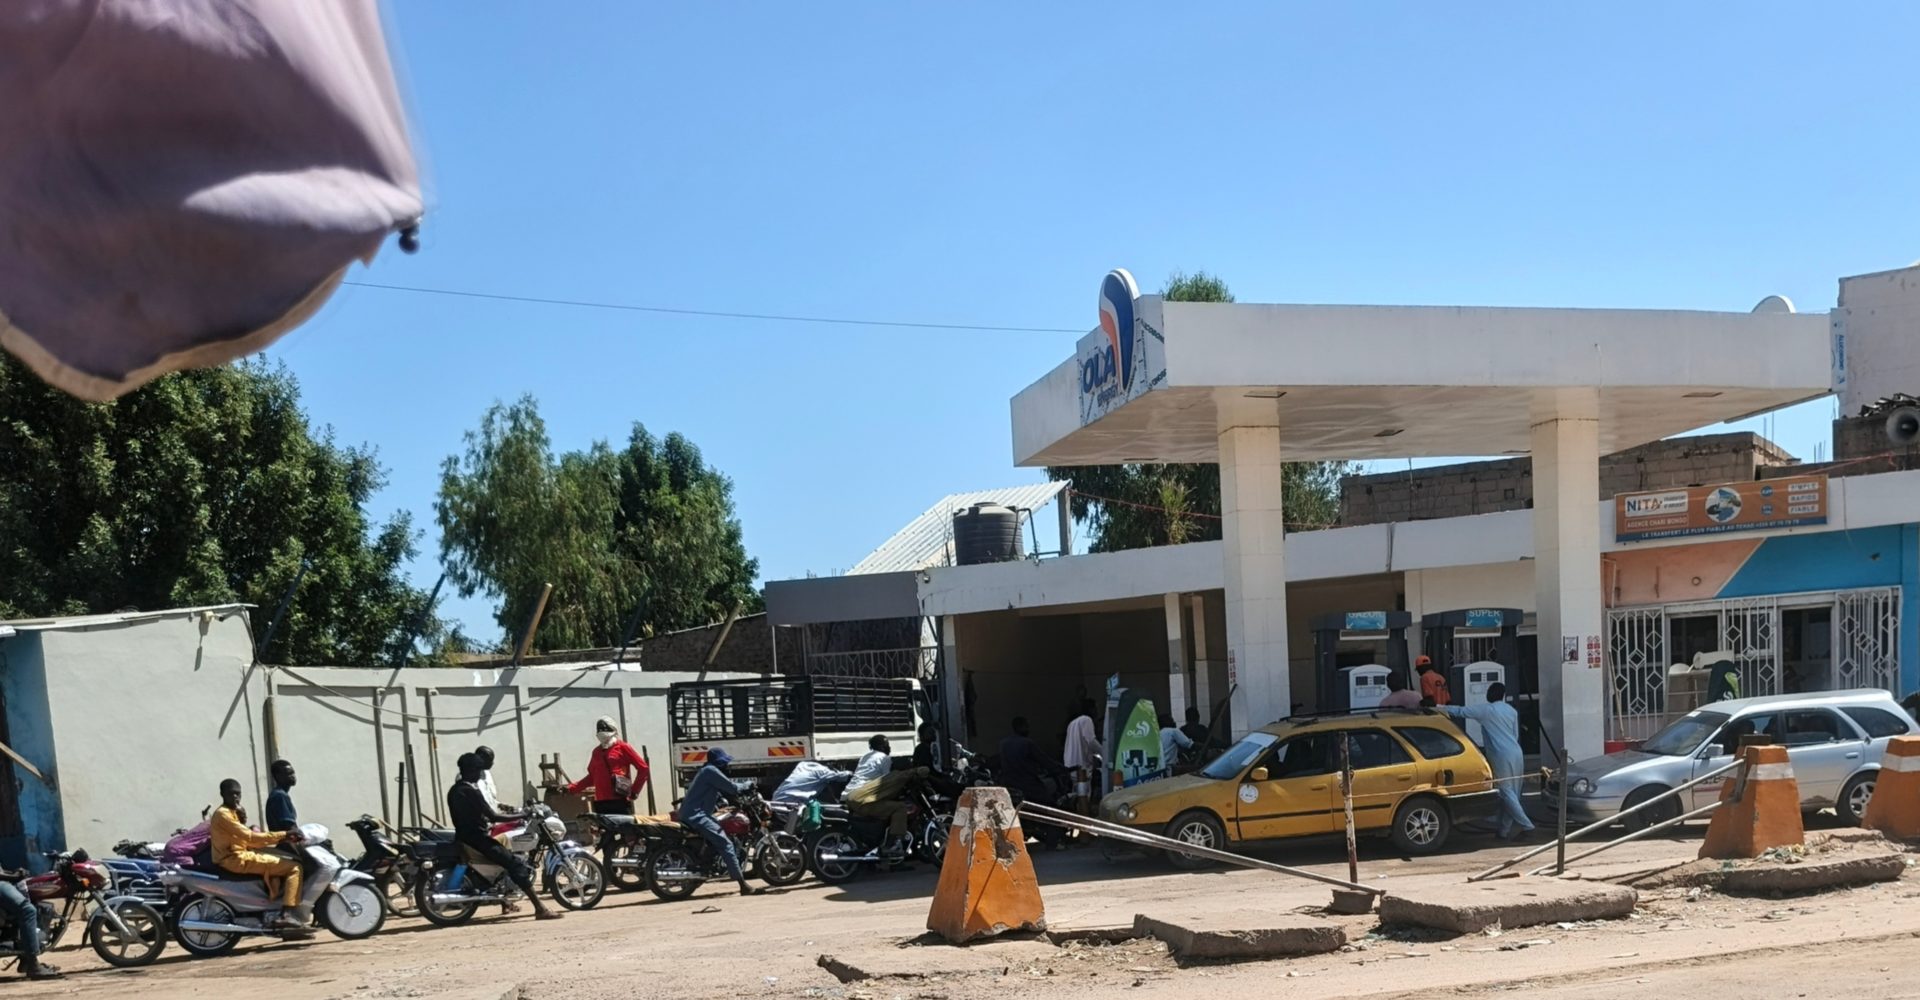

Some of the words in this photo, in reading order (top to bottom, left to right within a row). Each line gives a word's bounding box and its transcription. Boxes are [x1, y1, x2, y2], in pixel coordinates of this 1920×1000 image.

[1083, 344, 1116, 393] OLA
[1627, 498, 1662, 512] NITA
[1627, 519, 1649, 528] AGENCE
[1469, 609, 1500, 617] SUPER
[1127, 729, 1143, 737] OLA
